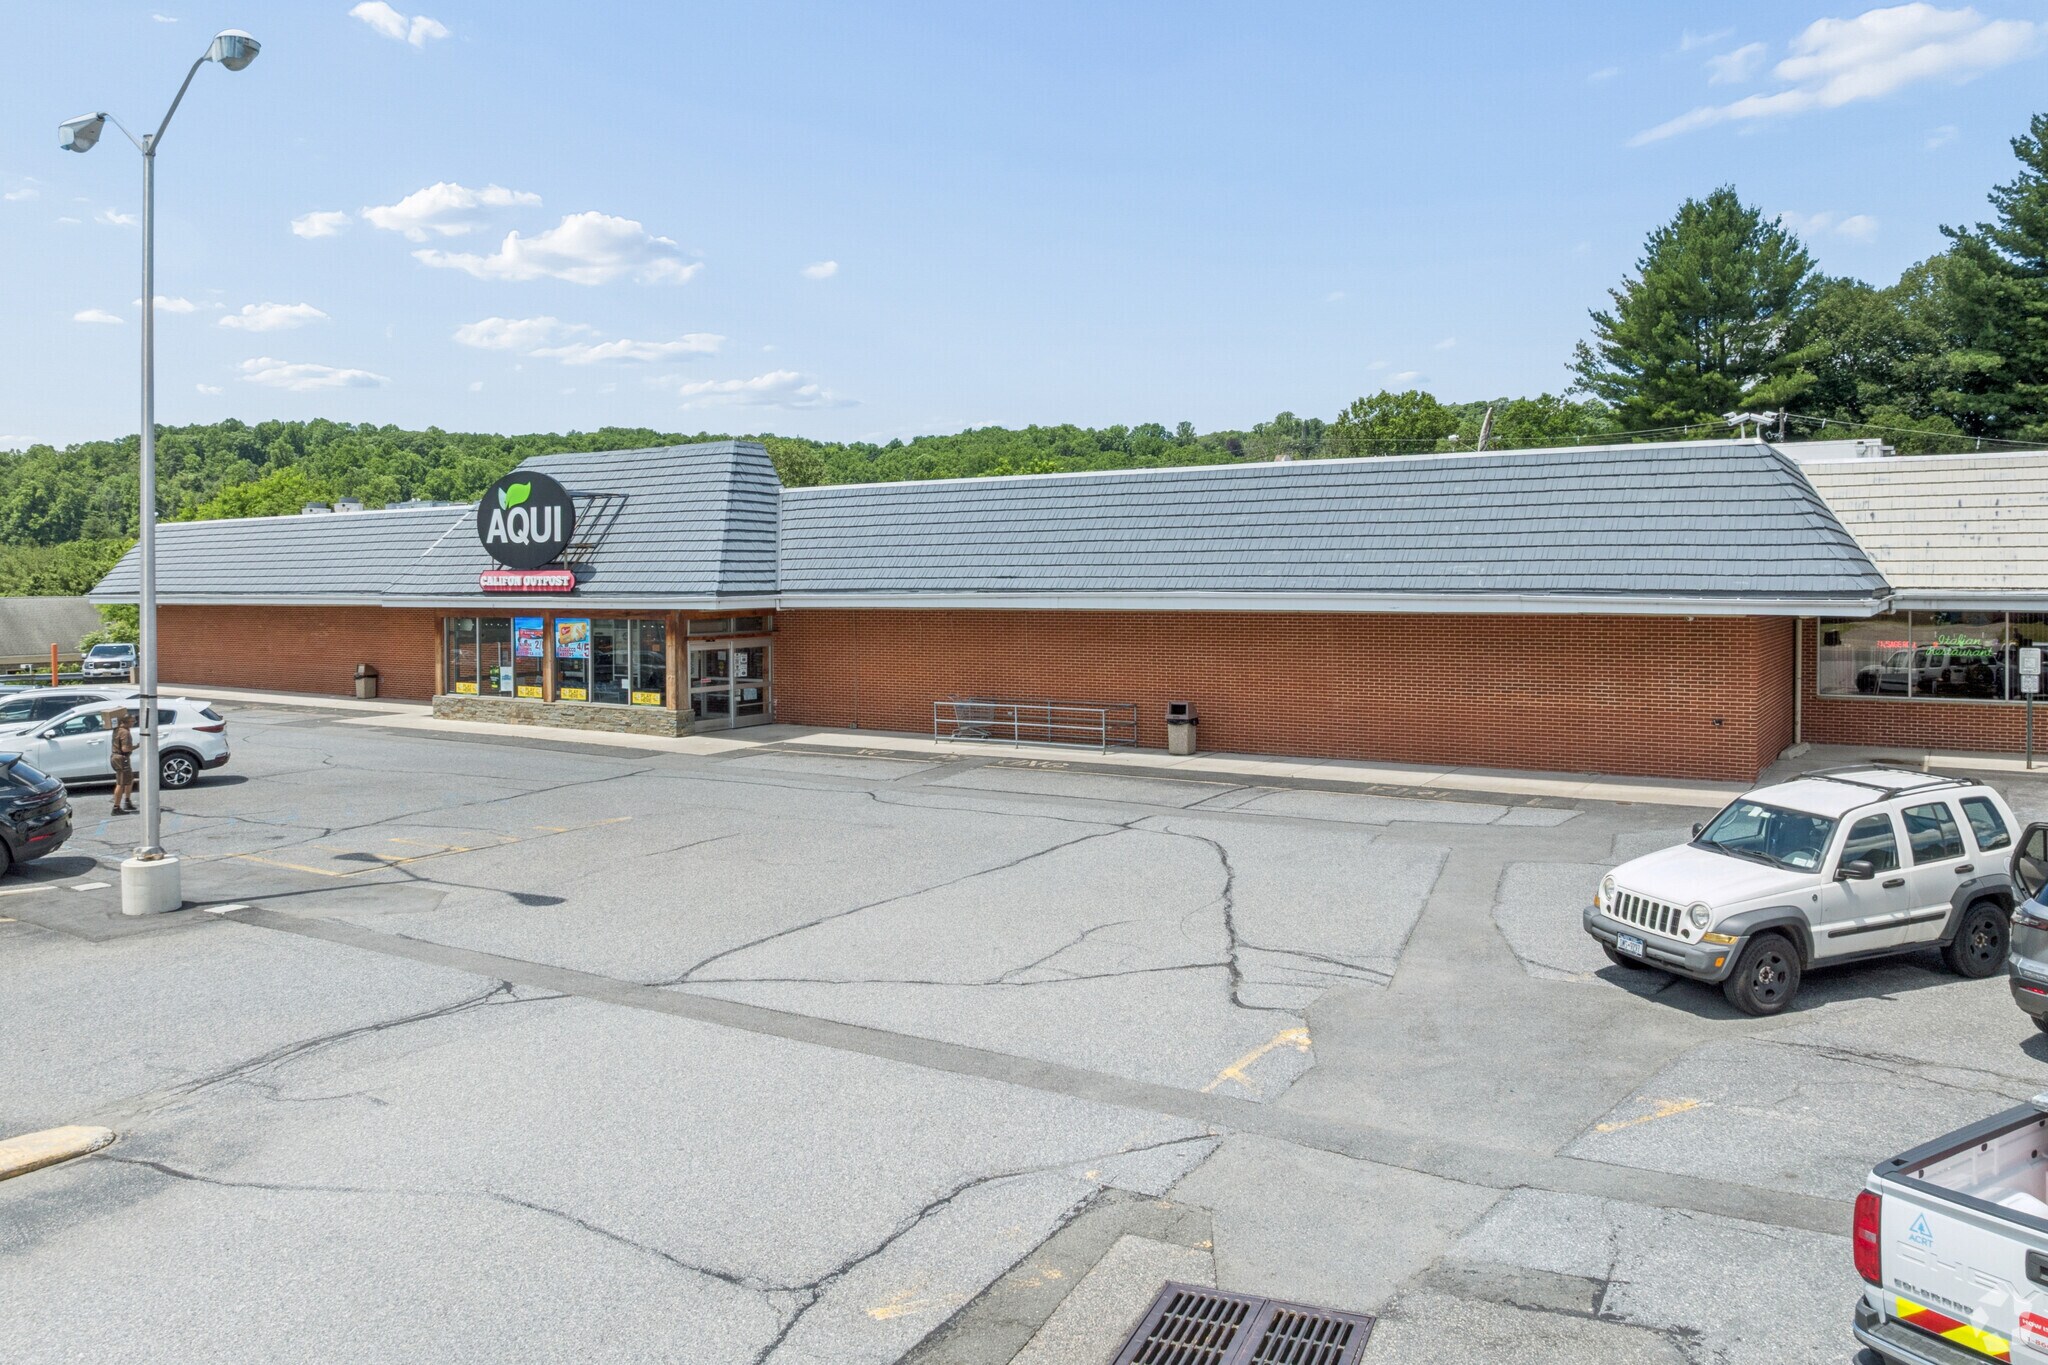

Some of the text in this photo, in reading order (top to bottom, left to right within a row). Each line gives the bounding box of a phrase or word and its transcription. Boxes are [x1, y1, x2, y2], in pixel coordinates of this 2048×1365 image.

[486, 506, 562, 546] AQUI
[480, 575, 570, 586] CALIFON OUTPOST
[1938, 634, 1981, 647] Italian
[1925, 646, 1993, 657] Restaurant
[1908, 1234, 1934, 1248] ACRT
[1894, 1278, 1974, 1315] COLORADO
[2022, 1318, 2042, 1330] HOW
